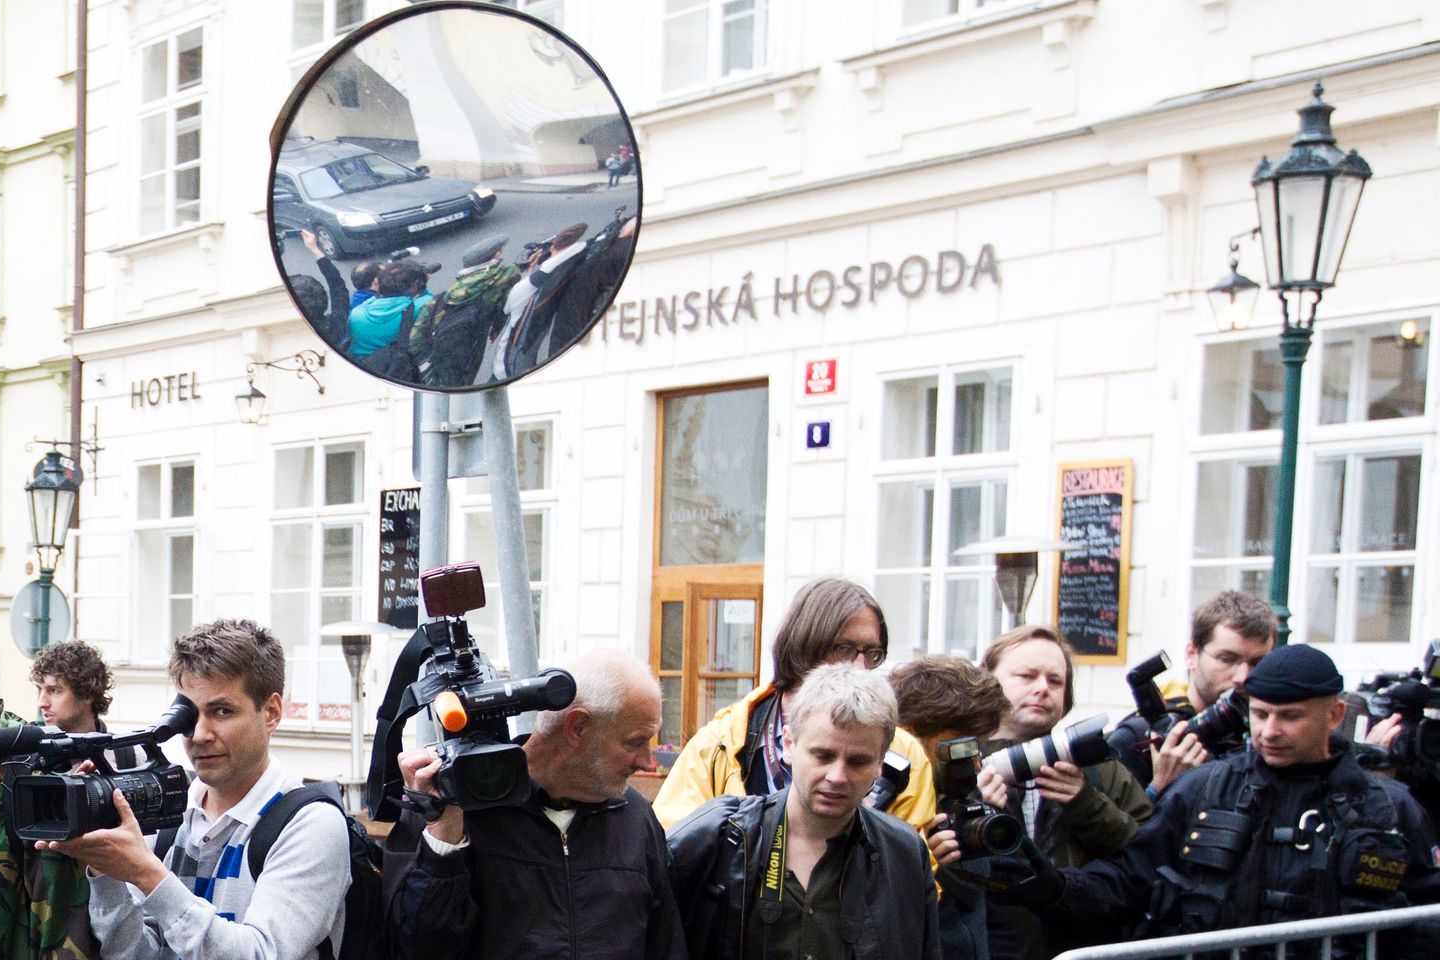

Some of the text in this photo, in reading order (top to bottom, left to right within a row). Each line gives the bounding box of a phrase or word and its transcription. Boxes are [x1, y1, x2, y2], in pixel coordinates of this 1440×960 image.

[579, 243, 1001, 347] TEJNSKÁ HOSPODA
[131, 371, 202, 409] HOTEL
[766, 852, 780, 890] Nikon
